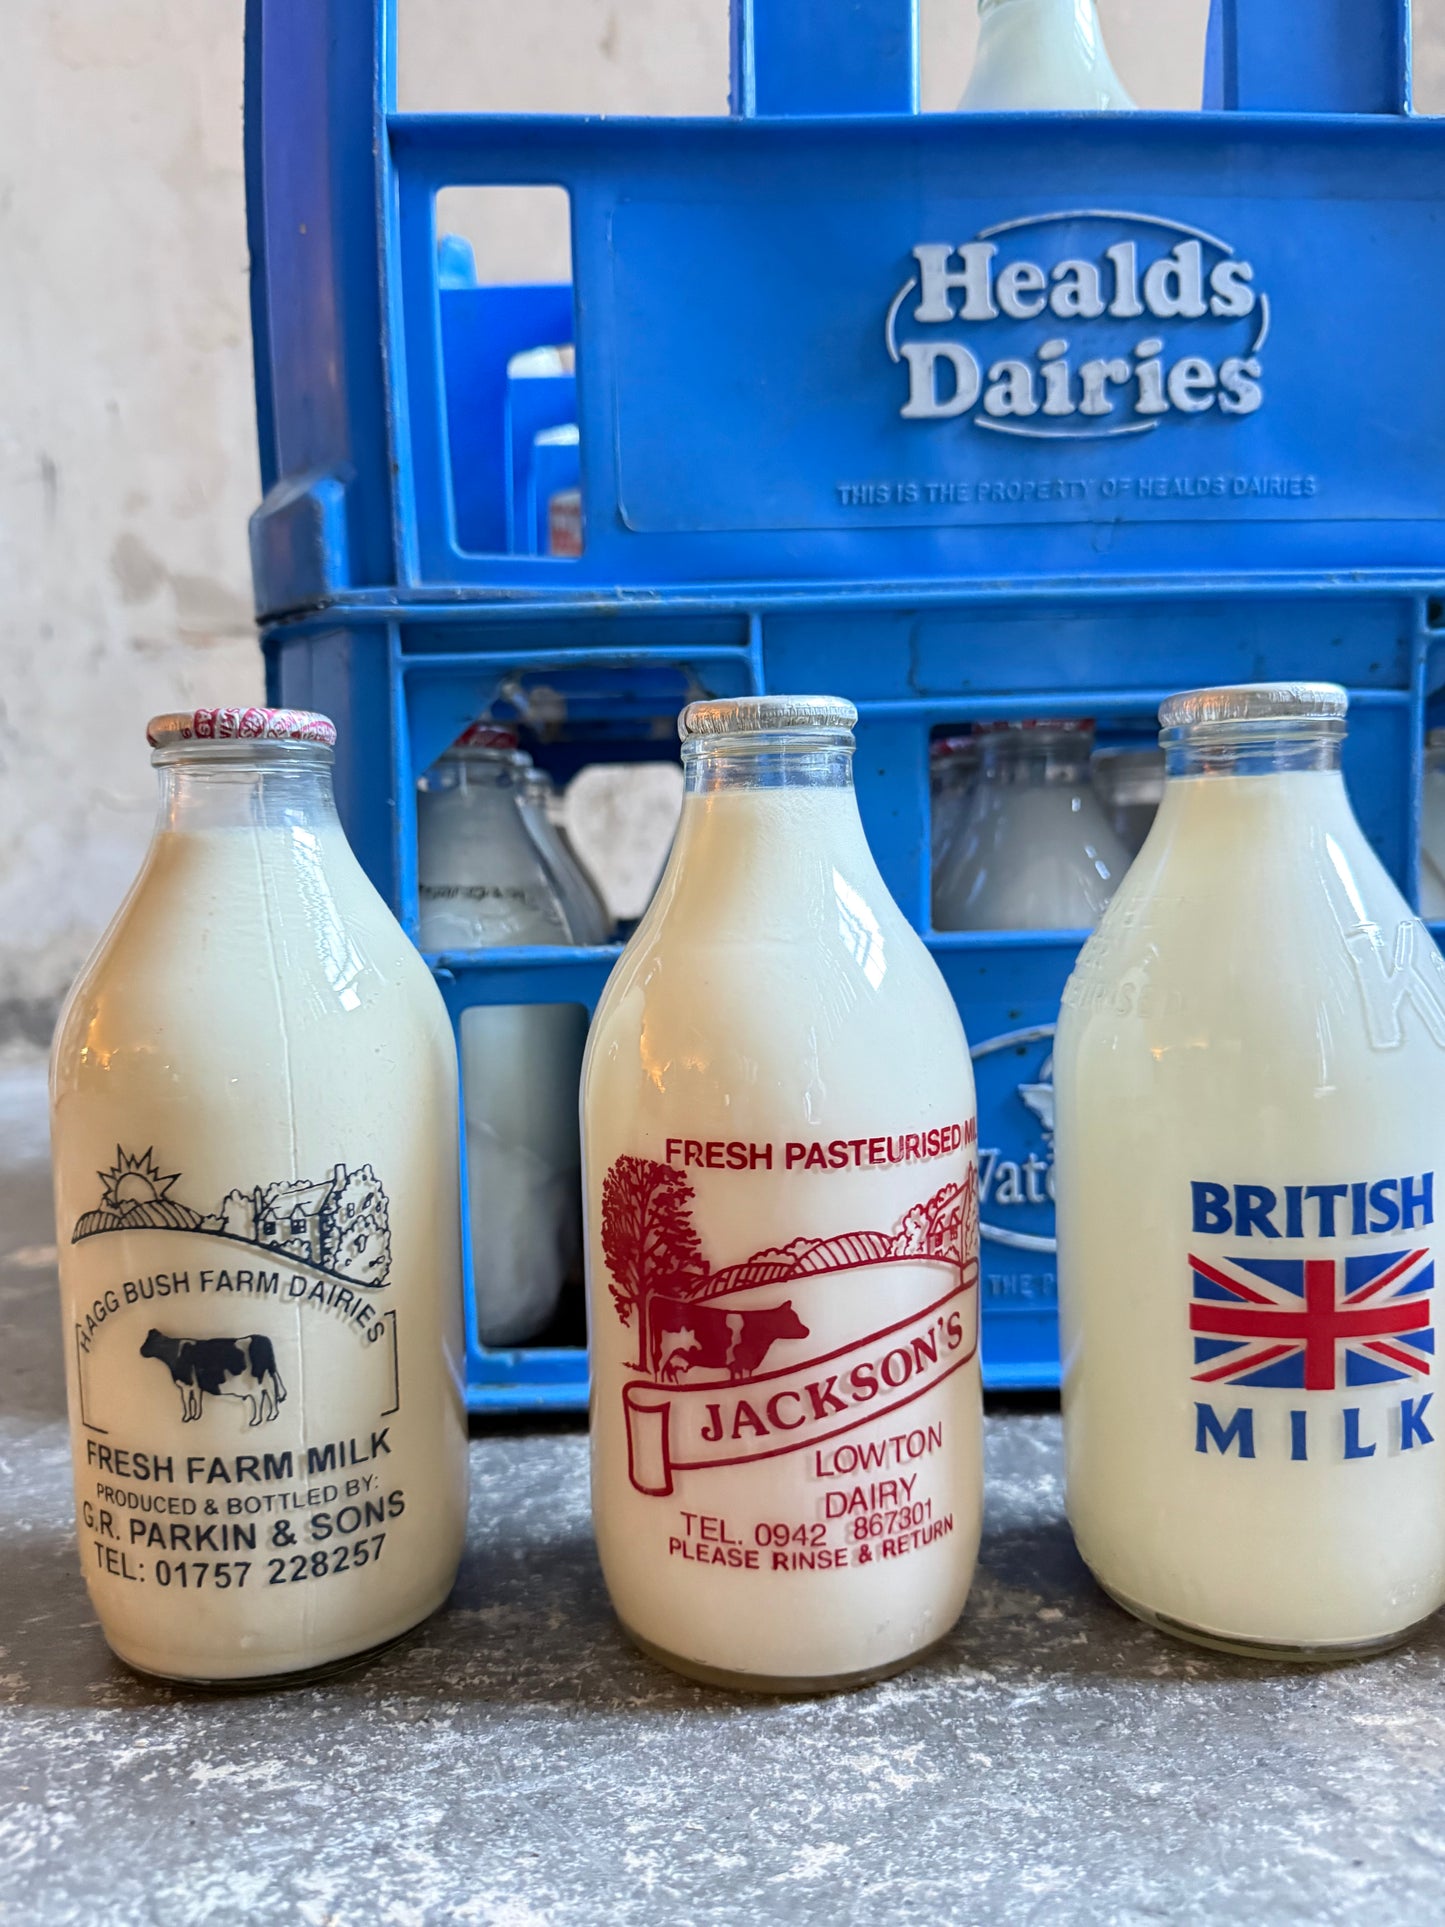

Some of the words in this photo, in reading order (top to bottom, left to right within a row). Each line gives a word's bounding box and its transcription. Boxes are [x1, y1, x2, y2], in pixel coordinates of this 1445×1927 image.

[912, 240, 1256, 323] Healds
[899, 338, 1263, 419] Dairies
[837, 483, 889, 505] THIS
[897, 483, 920, 503] IS
[925, 482, 970, 503] THE
[977, 478, 1095, 502] PROPERTY
[1101, 477, 1132, 497] OF
[1138, 476, 1225, 497] HEALDS
[1232, 474, 1317, 496] DAIRIES
[665, 1138, 773, 1170] FRESH
[785, 1125, 962, 1170] PASTEURISED
[1190, 1170, 1435, 1239] BRITISH
[79, 1290, 121, 1354] HAGG
[122, 1271, 191, 1305] BUSH
[200, 1269, 279, 1295] FARM
[288, 1274, 388, 1345] DAIRIES
[700, 1311, 964, 1442] JACKSON'S
[86, 1438, 174, 1483] FRESH
[187, 1451, 294, 1484] FARM
[308, 1427, 392, 1475] MILK
[815, 1420, 943, 1478] LOWTON
[1193, 1392, 1435, 1461] MILK
[82, 1500, 121, 1540] G.R.
[129, 1518, 257, 1552] PARKIN
[272, 1519, 297, 1547] &
[310, 1489, 406, 1540] SONS
[96, 1482, 197, 1516] PRODUCED
[204, 1499, 219, 1515] &
[227, 1484, 338, 1515] BOTTLED
[345, 1474, 379, 1496] BY:
[680, 1511, 743, 1546] TEL.
[754, 1522, 827, 1548] 0942
[853, 1497, 933, 1541] 867301
[825, 1473, 918, 1519] DAIRY
[93, 1541, 146, 1583] TEL:
[155, 1560, 252, 1588] 01757
[267, 1532, 387, 1585] 228257
[669, 1536, 760, 1570] PLEASE
[772, 1547, 848, 1571] RINSE
[858, 1543, 872, 1564] &
[882, 1513, 954, 1559] RETURN
